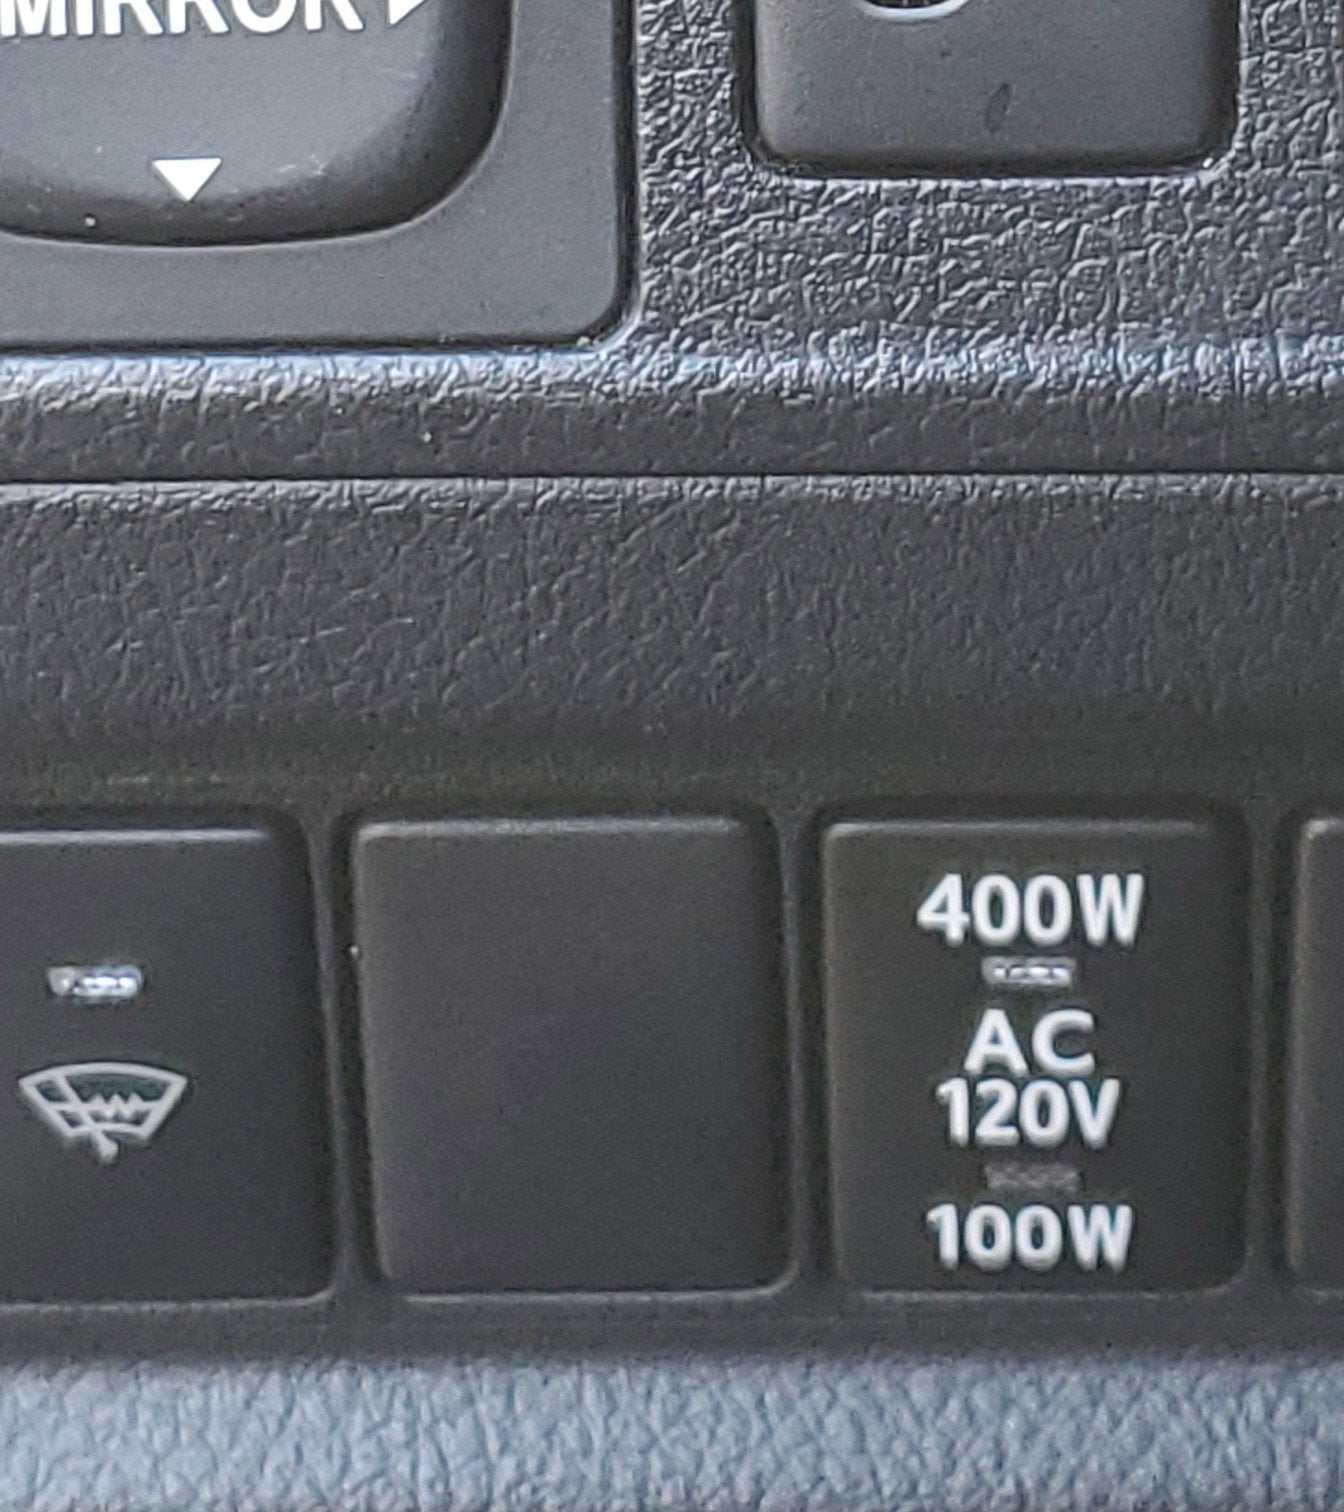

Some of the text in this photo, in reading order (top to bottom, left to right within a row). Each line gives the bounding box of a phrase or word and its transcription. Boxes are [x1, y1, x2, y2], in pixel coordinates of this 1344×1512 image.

[916, 873, 1145, 947] 400W
[963, 1007, 1097, 1077] AC
[935, 1076, 1122, 1148] 120V
[925, 1203, 1134, 1271] 100W
